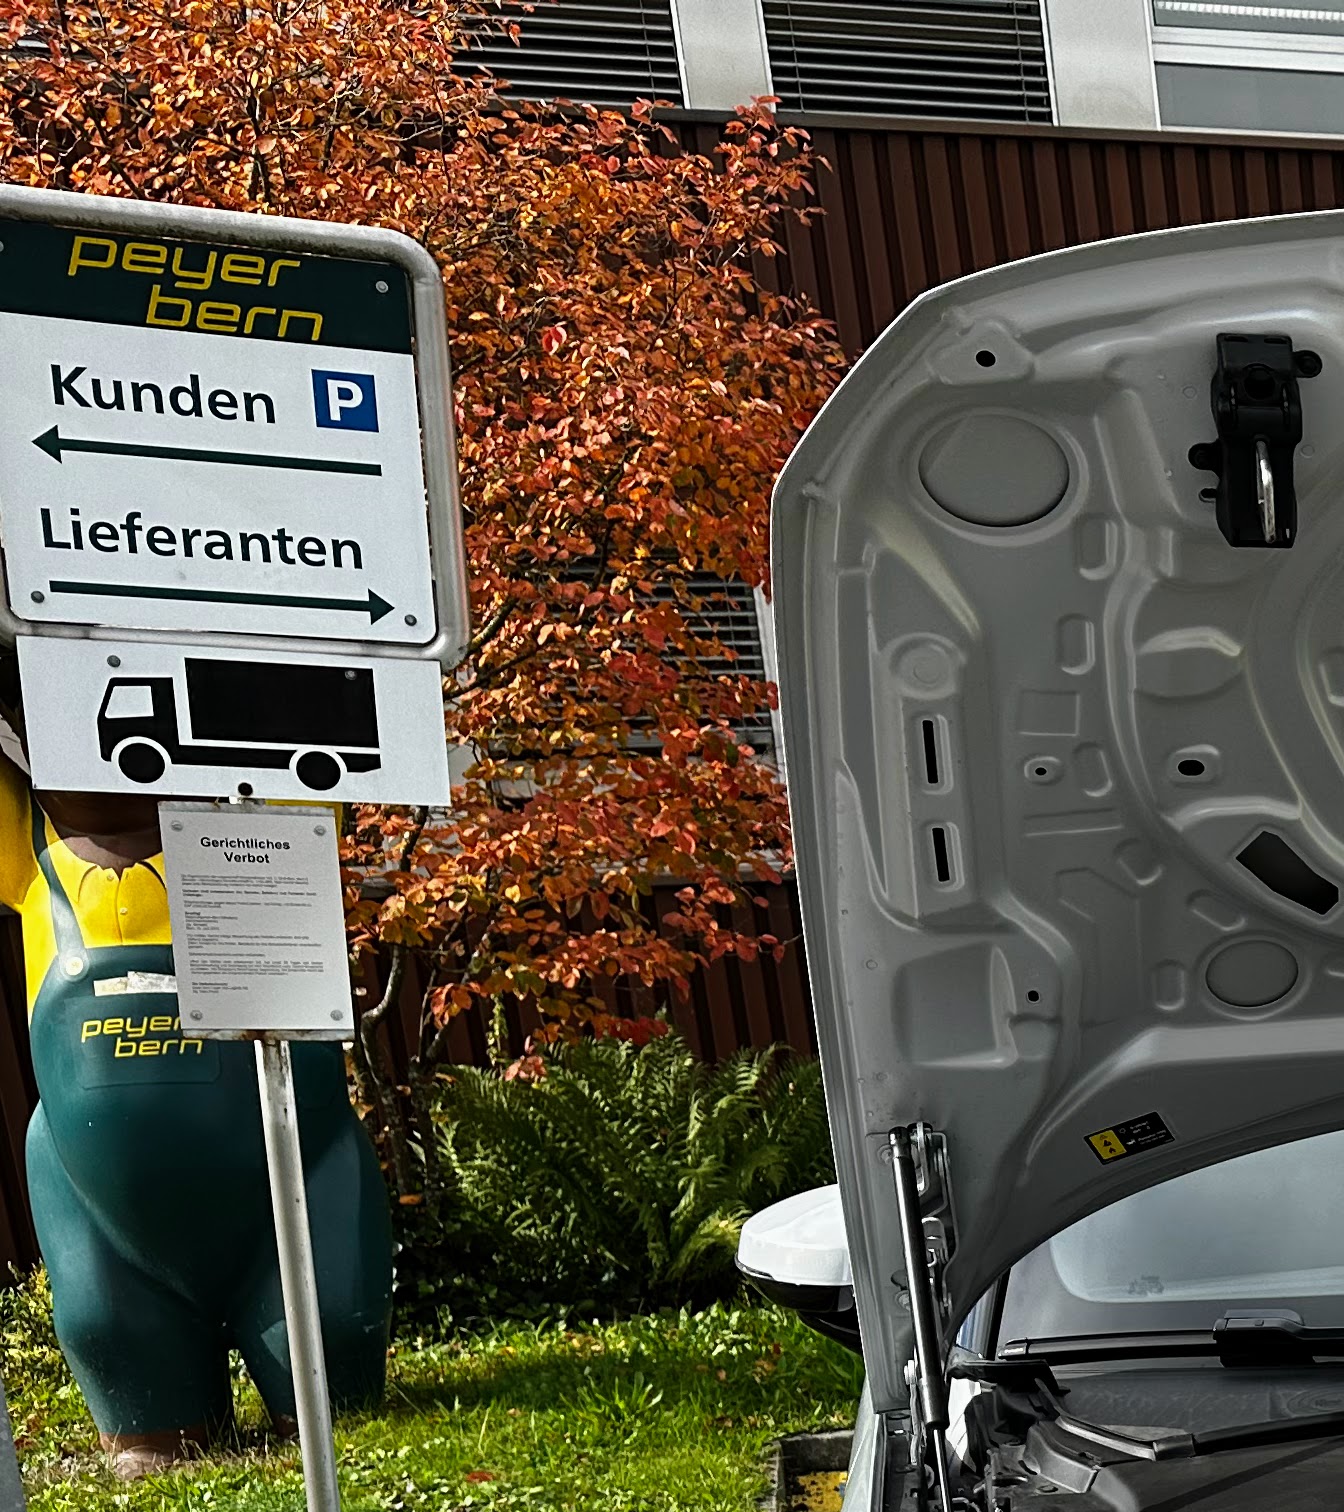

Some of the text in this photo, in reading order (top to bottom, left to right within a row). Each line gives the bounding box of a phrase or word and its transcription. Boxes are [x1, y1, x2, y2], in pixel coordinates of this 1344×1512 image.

[67, 235, 301, 290] peyer
[146, 285, 324, 341] bern
[50, 363, 364, 424] Kunden P
[40, 507, 364, 570] Lieferanten
[200, 836, 291, 850] Gerichtliches
[223, 851, 270, 864] Verbot
[114, 1037, 203, 1058] bern
